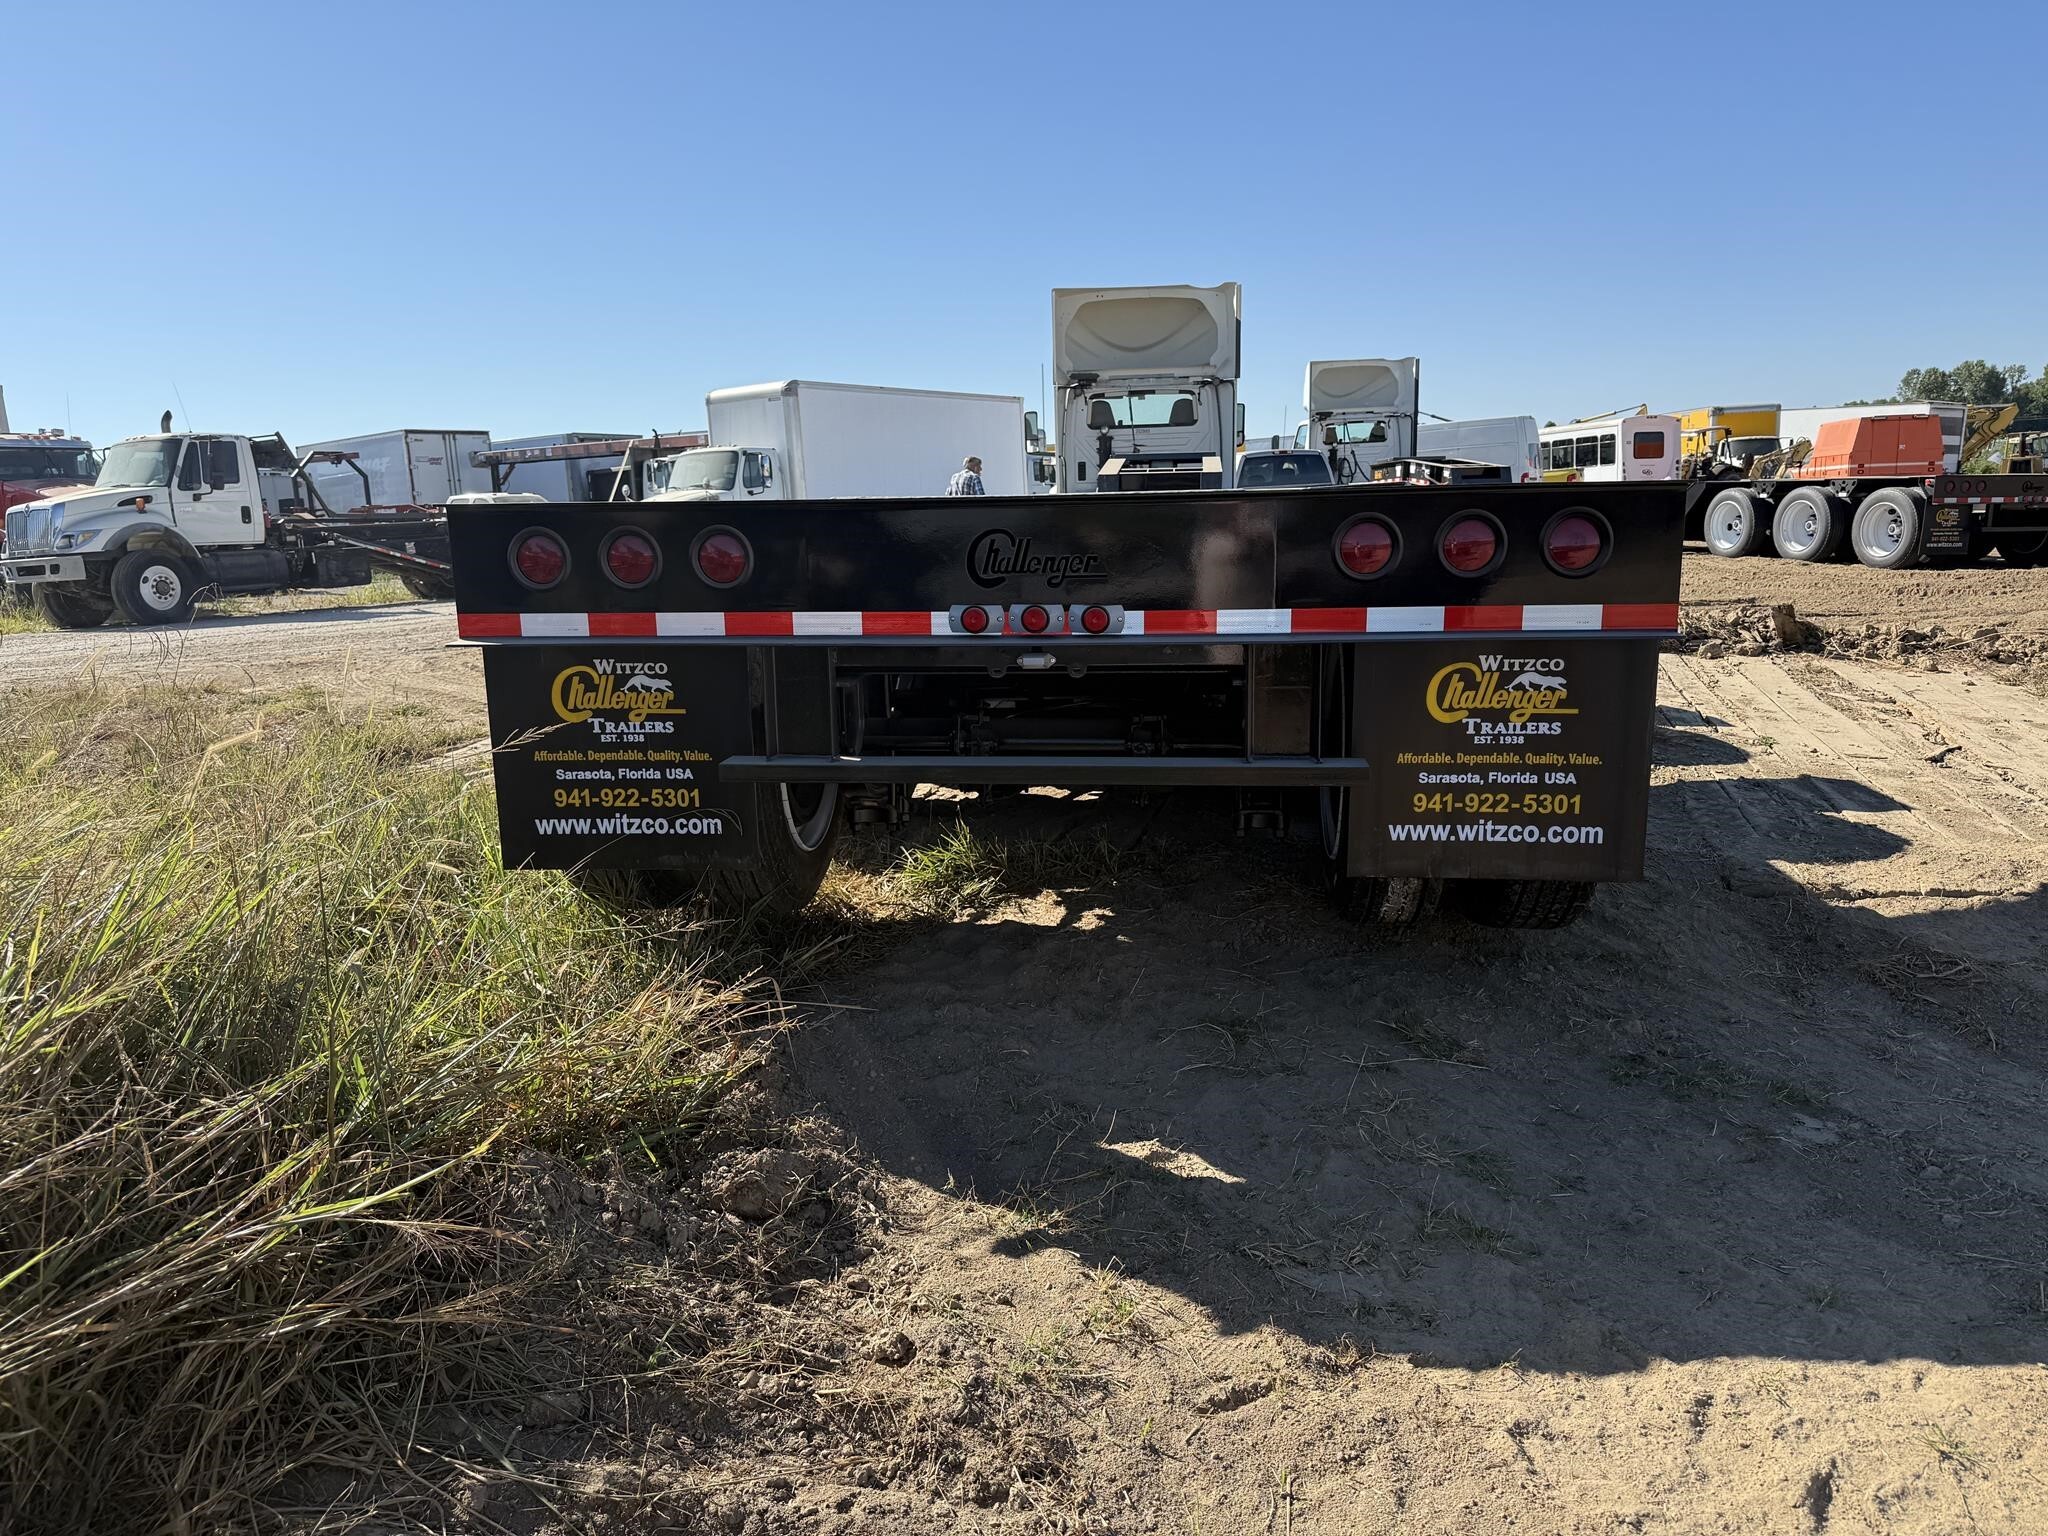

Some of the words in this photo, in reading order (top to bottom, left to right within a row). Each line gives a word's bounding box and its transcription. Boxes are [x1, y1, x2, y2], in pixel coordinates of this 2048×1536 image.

[966, 528, 1108, 588] Challenger
[593, 659, 668, 675] WITZCO
[1478, 654, 1565, 672] WITZCO
[551, 665, 686, 723] Challenger
[1426, 662, 1579, 723] Challenger
[587, 718, 674, 734] TRAILERS
[1462, 718, 1562, 735] TRAILERS
[600, 734, 620, 742] EST.
[623, 734, 644, 742] 1938
[1474, 736, 1495, 744] EST.
[1499, 736, 1524, 744] 1938
[534, 750, 586, 761] Affordable.
[587, 750, 646, 763] Dependable.
[647, 750, 683, 763] Quality.
[684, 750, 713, 761] Value.
[1397, 752, 1454, 764] Affordable.
[1457, 752, 1523, 766] Dependable.
[1525, 752, 1566, 766] Quality.
[1568, 753, 1603, 766] Value.
[556, 769, 615, 781] Sarasota,
[618, 768, 661, 780] Florida
[666, 769, 693, 780] USA
[1418, 772, 1484, 785] Sarasota,
[1488, 772, 1538, 784] Florida
[1544, 772, 1577, 785] USA
[553, 788, 700, 808] 941-922-5301
[1413, 793, 1581, 815] 941-922-5301
[535, 813, 722, 835] www.witzco.com
[1388, 820, 1604, 844] www.witzco.com
